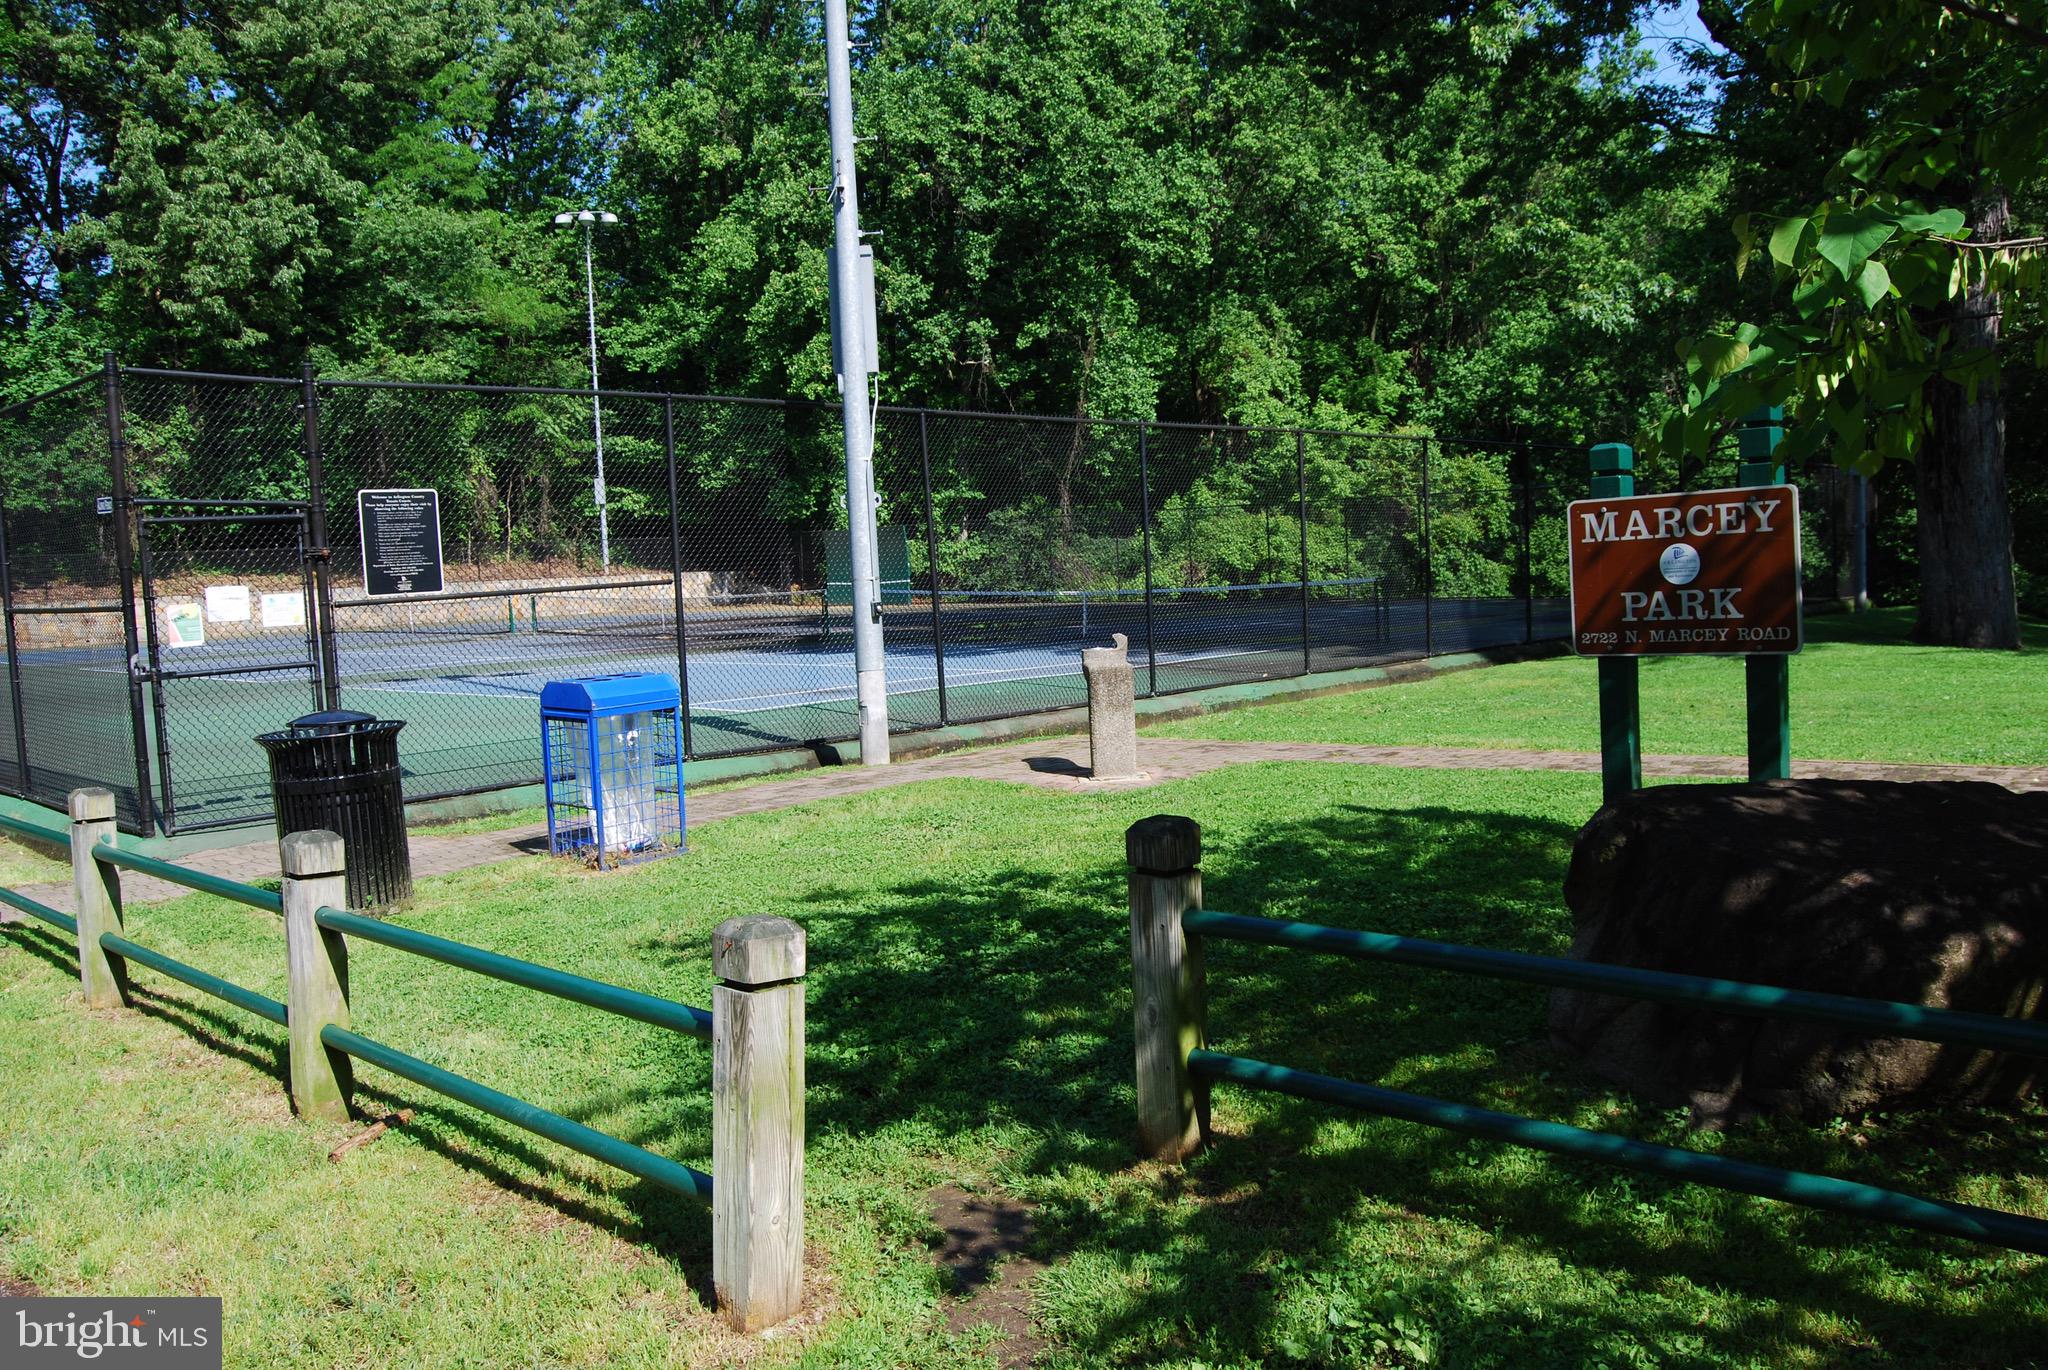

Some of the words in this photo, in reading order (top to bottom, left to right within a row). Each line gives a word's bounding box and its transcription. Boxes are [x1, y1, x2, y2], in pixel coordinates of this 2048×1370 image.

[1581, 500, 1781, 543] MARCEY
[1620, 588, 1745, 622] PARK
[1581, 632, 1618, 644] 2722
[1625, 630, 1642, 643] N.
[1649, 628, 1729, 643] MARCEY
[1737, 626, 1791, 641] ROAD
